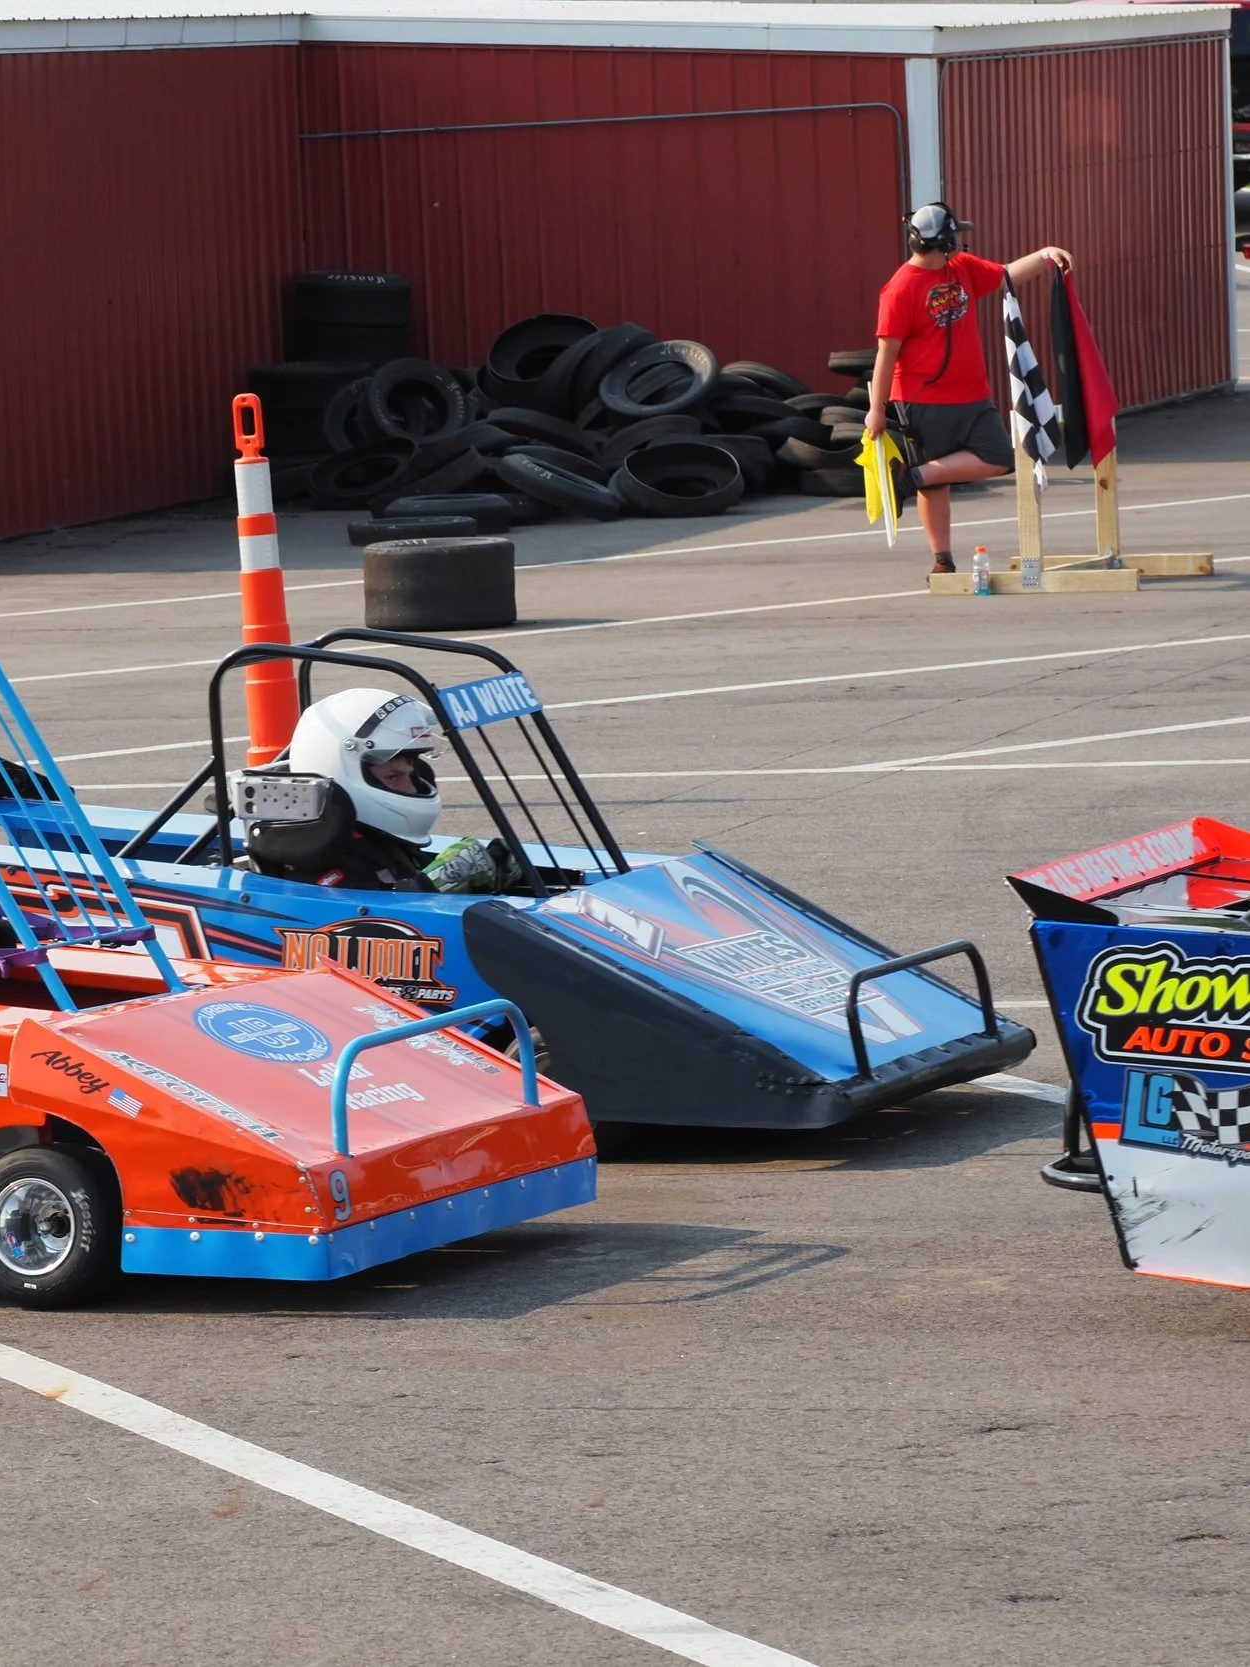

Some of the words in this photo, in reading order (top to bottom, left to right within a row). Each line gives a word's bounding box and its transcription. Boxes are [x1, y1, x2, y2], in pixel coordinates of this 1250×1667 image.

[446, 689, 478, 727] AJ
[471, 676, 539, 716] WHITE
[284, 932, 330, 970] NO
[336, 936, 439, 982] LIMIT
[691, 933, 810, 976] WHITES
[417, 988, 455, 1001] PARTS
[267, 1042, 328, 1062] MACHINE
[1123, 1026, 1231, 1058] AUTO
[30, 1050, 110, 1095] Abbey
[329, 1170, 352, 1222] 9
